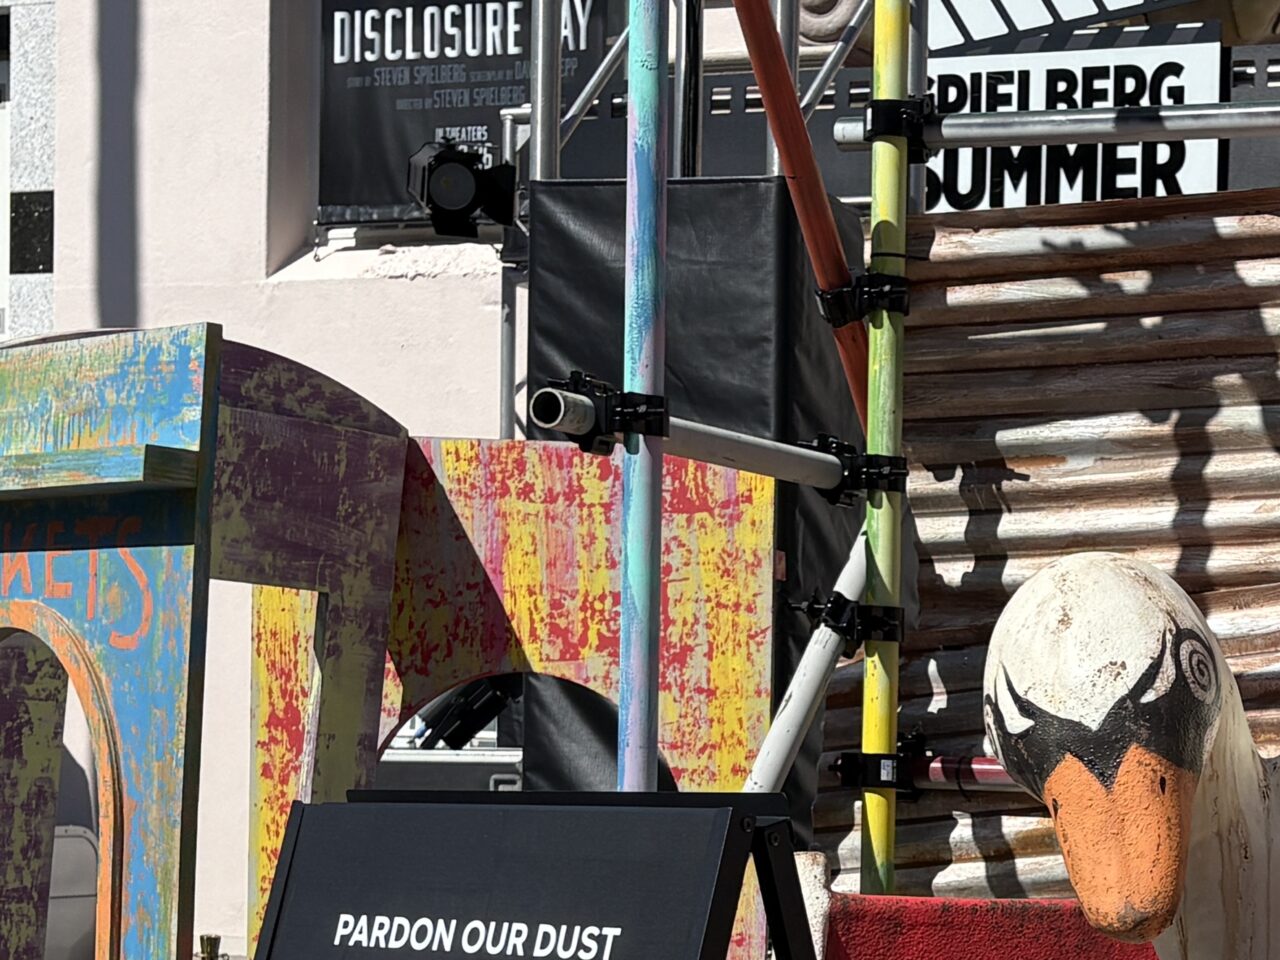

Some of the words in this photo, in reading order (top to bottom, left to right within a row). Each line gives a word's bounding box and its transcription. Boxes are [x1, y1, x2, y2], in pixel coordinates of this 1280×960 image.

[333, 1, 523, 64] DISCLOSURE
[560, 0, 592, 51] AY
[374, 66, 410, 86] STEVEN
[414, 64, 466, 85] SPIELBERG
[927, 61, 1185, 113] PIELBERG
[433, 88, 470, 108] STEVEN
[473, 85, 525, 106] SPIELBERG
[445, 126, 488, 142] THEATERS
[333, 914, 456, 952] PARDON
[461, 920, 528, 957] OUR
